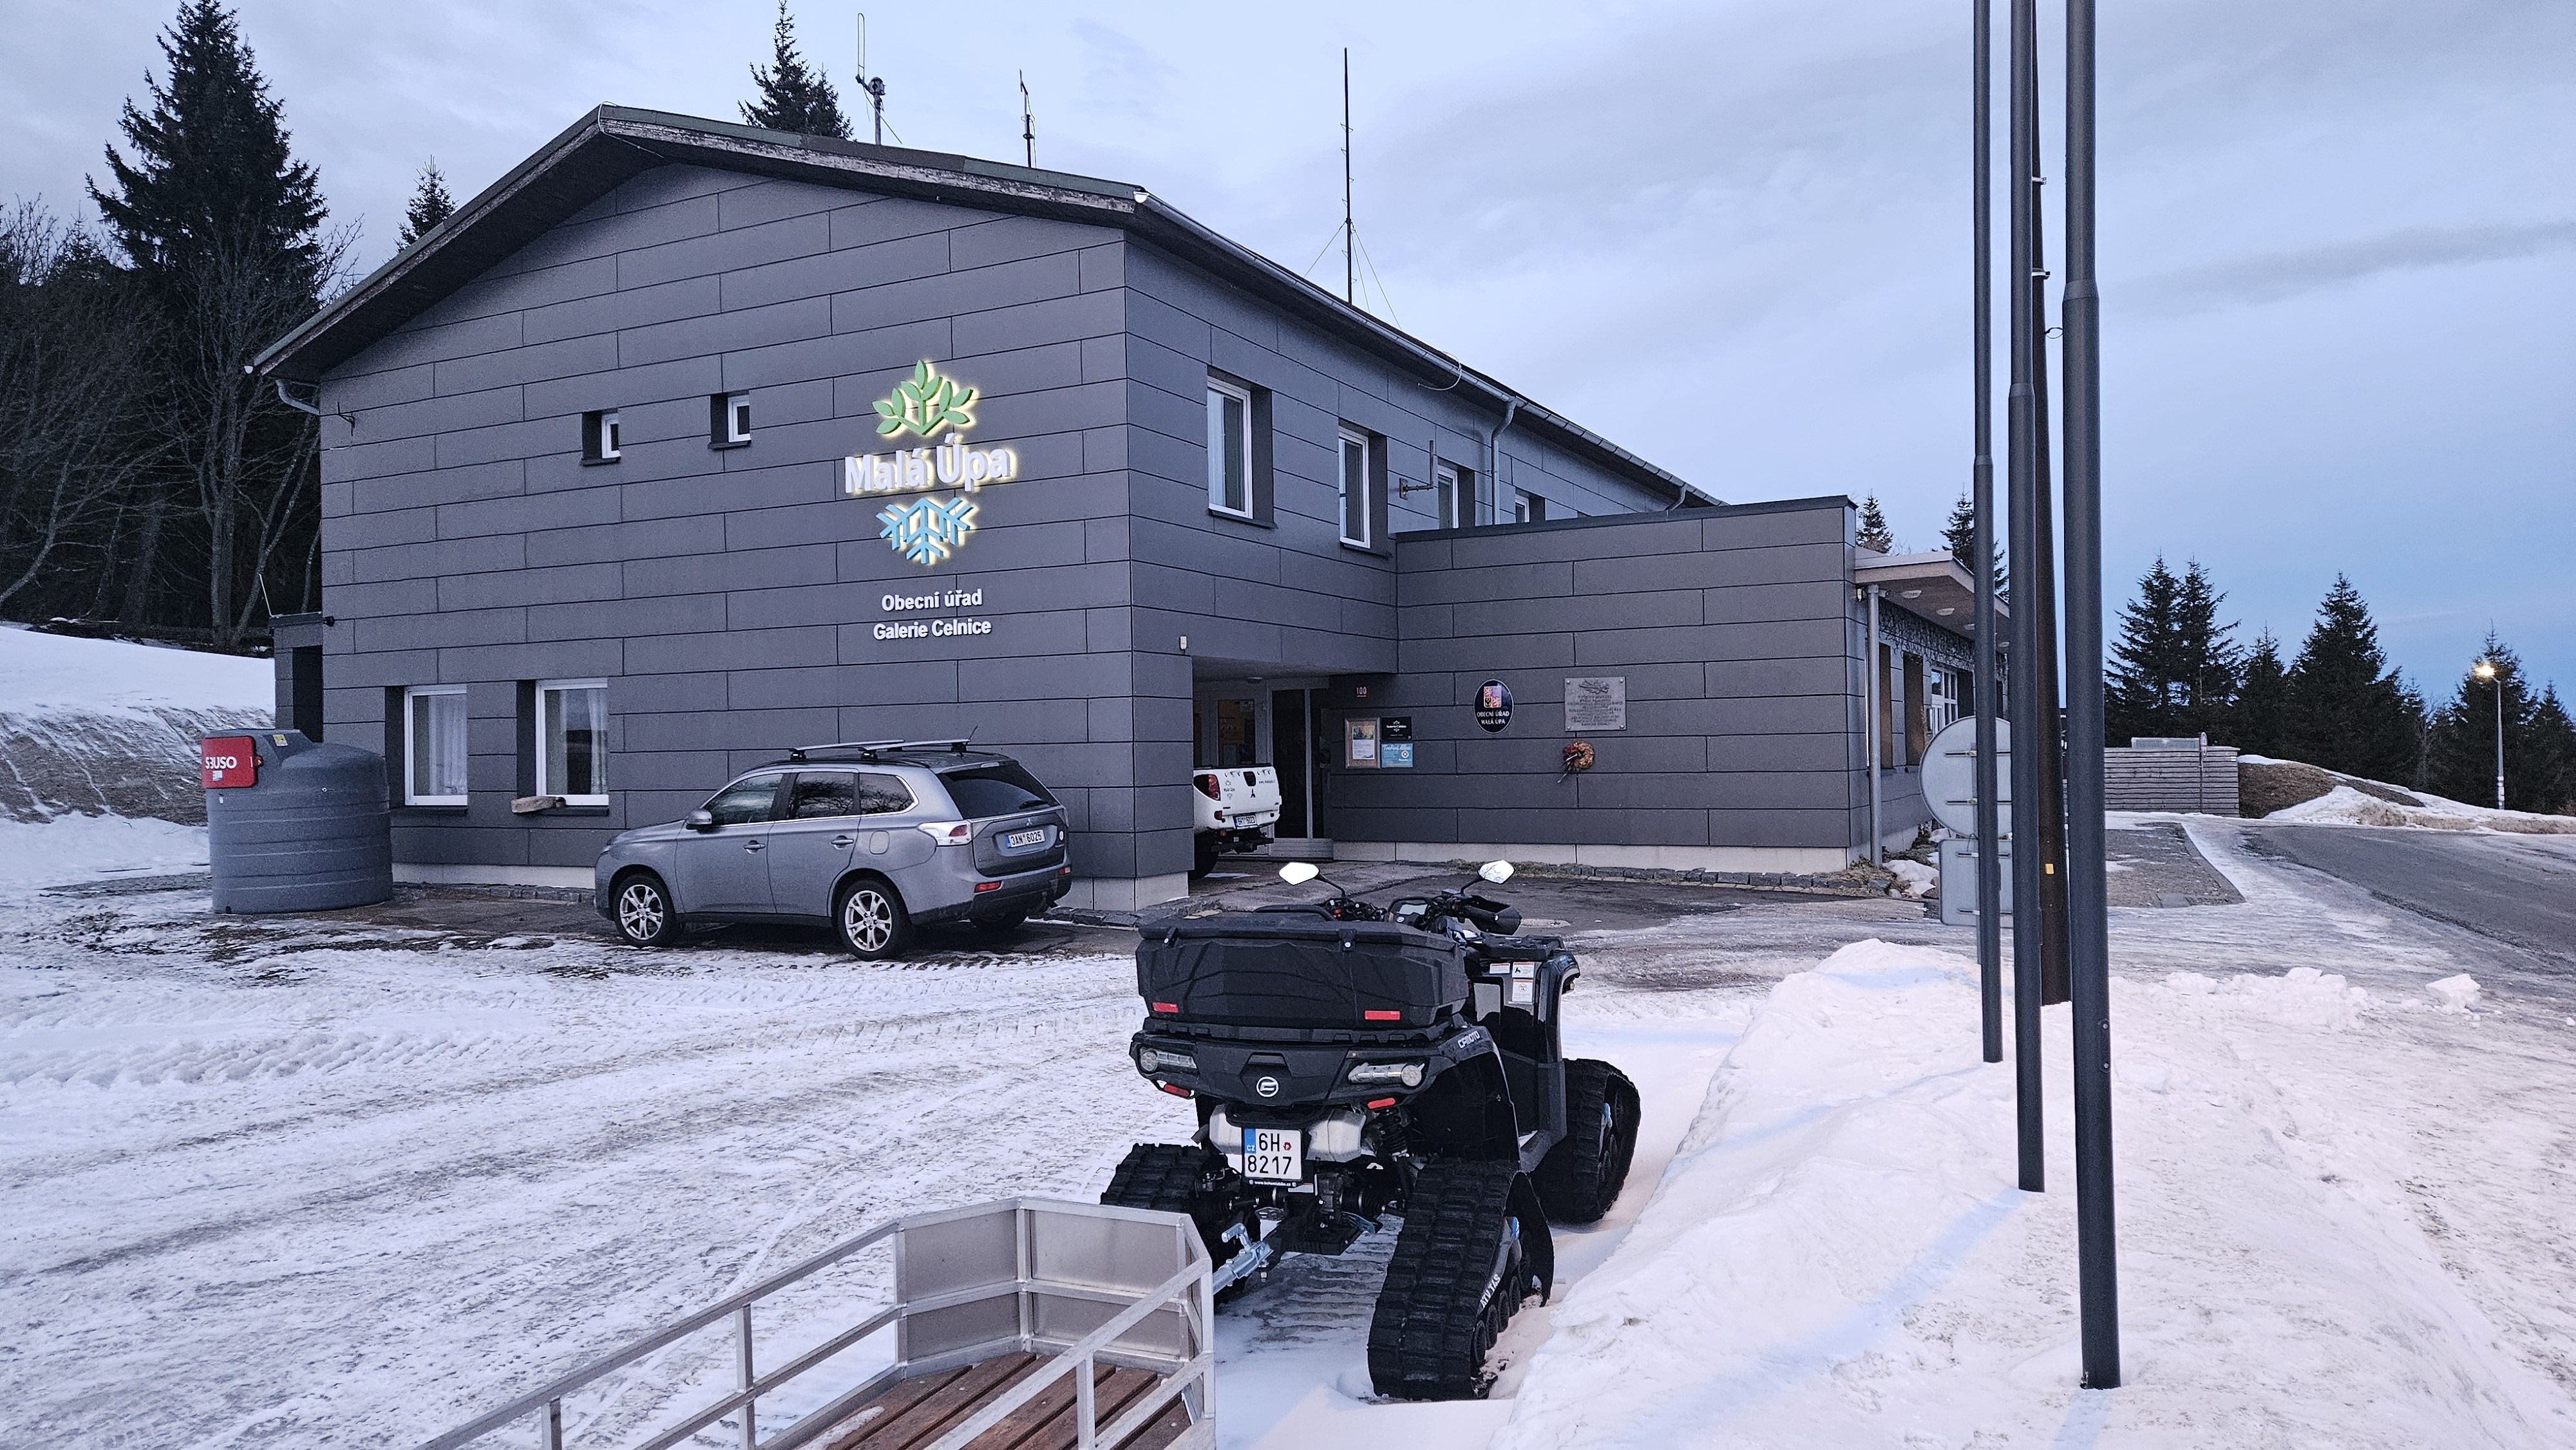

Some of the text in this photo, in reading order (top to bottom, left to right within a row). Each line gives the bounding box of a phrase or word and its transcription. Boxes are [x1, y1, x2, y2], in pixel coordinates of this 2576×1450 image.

[844, 433, 1013, 494] Malá Úpa
[882, 588, 983, 612] Obecní úřad
[873, 618, 992, 640] Galerie Celnice
[1356, 686, 1367, 695] 100
[1010, 831, 1042, 845] 3AN 6025
[1258, 1133, 1280, 1152] 6H
[1247, 1154, 1292, 1175] 8217
[1480, 1289, 1492, 1308] ATV
